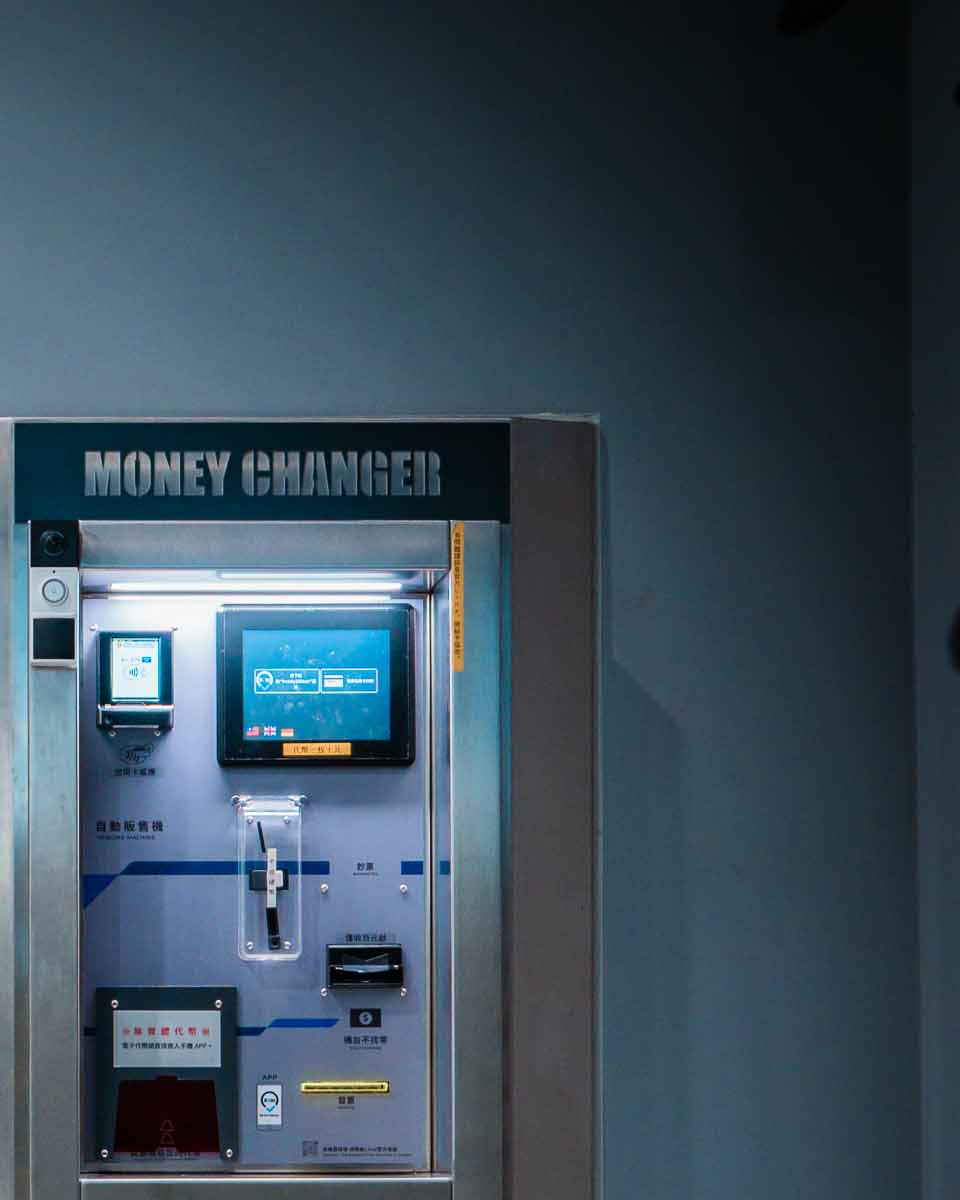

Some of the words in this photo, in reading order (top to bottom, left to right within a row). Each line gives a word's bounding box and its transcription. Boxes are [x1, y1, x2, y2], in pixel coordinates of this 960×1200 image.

[84, 450, 231, 497] MONEY
[241, 450, 441, 497] CHANGER
[96, 820, 163, 832] 自動販售機
